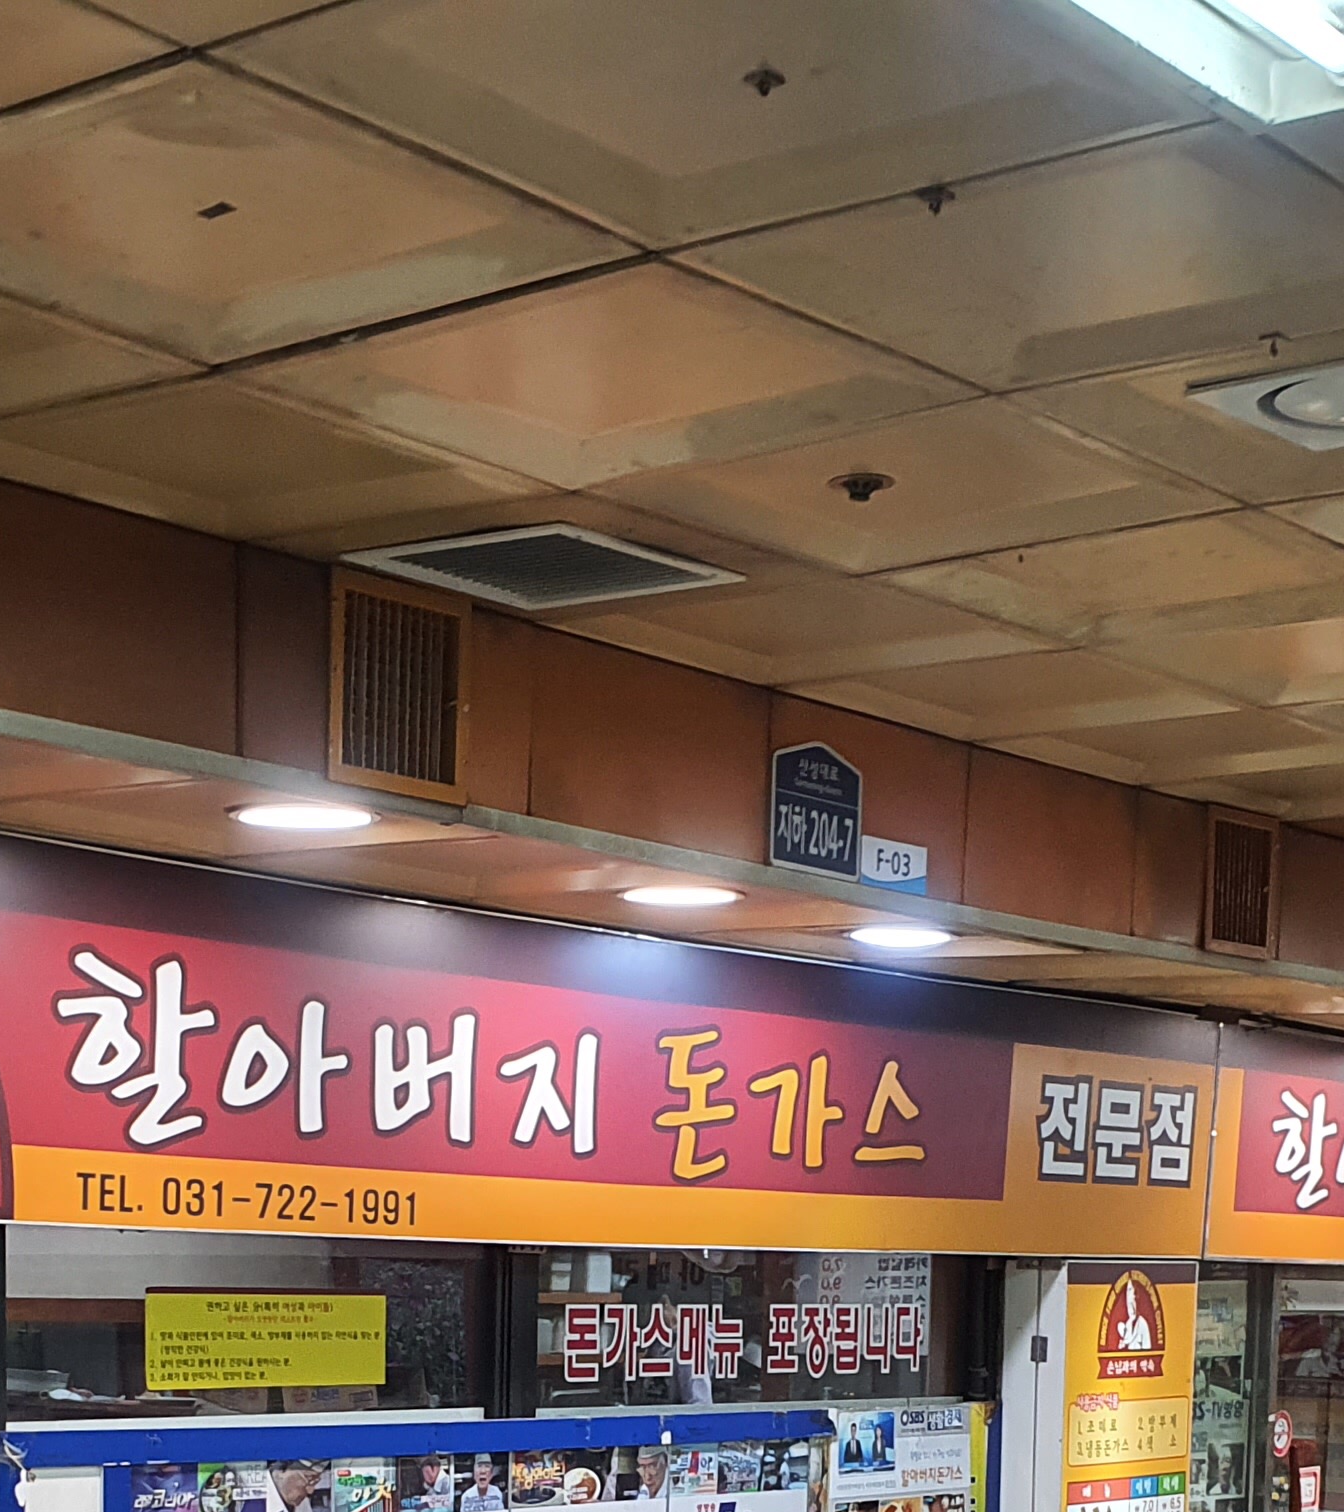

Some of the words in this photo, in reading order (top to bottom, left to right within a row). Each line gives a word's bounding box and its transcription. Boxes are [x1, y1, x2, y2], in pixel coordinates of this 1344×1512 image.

[777, 803, 807, 854] 지하
[809, 810, 854, 861] 204-7
[876, 848, 911, 877] F-03
[57, 950, 599, 1155] 할아버지
[655, 1029, 925, 1179] 돈가스
[1040, 1079, 1195, 1182] 전문점
[76, 1171, 145, 1213] TEL.
[162, 1178, 418, 1226] 031-722-1991
[565, 1304, 744, 1382] 돈가스메뉴
[767, 1304, 922, 1379] 포장됩니다
[909, 1410, 925, 1424] SBS
[901, 1466, 963, 1488] 할아버지돈가스
